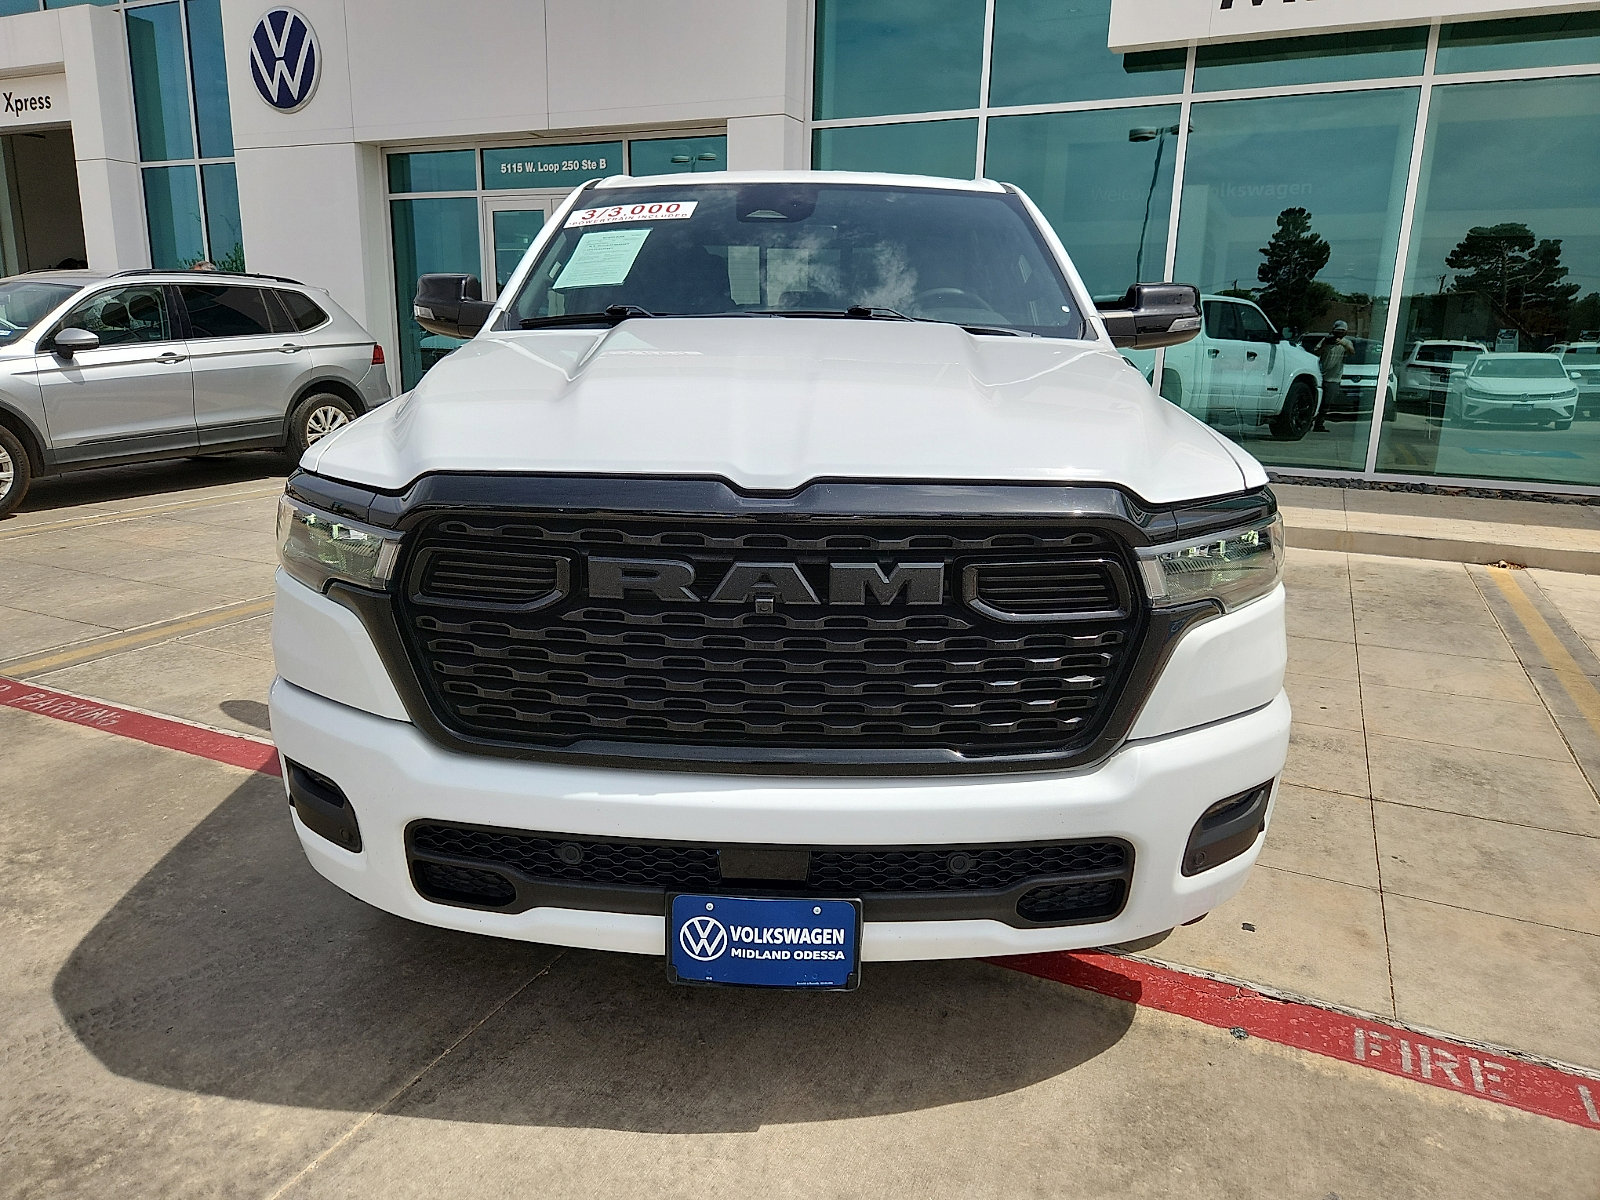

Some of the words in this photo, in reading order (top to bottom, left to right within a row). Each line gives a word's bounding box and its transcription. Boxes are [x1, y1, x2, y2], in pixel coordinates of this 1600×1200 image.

[2, 91, 52, 118] Xpress
[500, 162, 523, 174] 5115
[524, 161, 536, 173] W.
[537, 161, 560, 174] Loop
[561, 160, 580, 171] 250
[581, 159, 597, 170] Ste
[599, 158, 607, 169] B
[637, 212, 688, 220] INCLUDED
[587, 555, 946, 606] RAM
[7, 692, 124, 726] PARKING
[729, 925, 845, 945] VOLKSWAGEN
[730, 947, 791, 960] MIDLAND
[793, 949, 846, 960] ODESSA
[1353, 1027, 1509, 1099] FIRE
